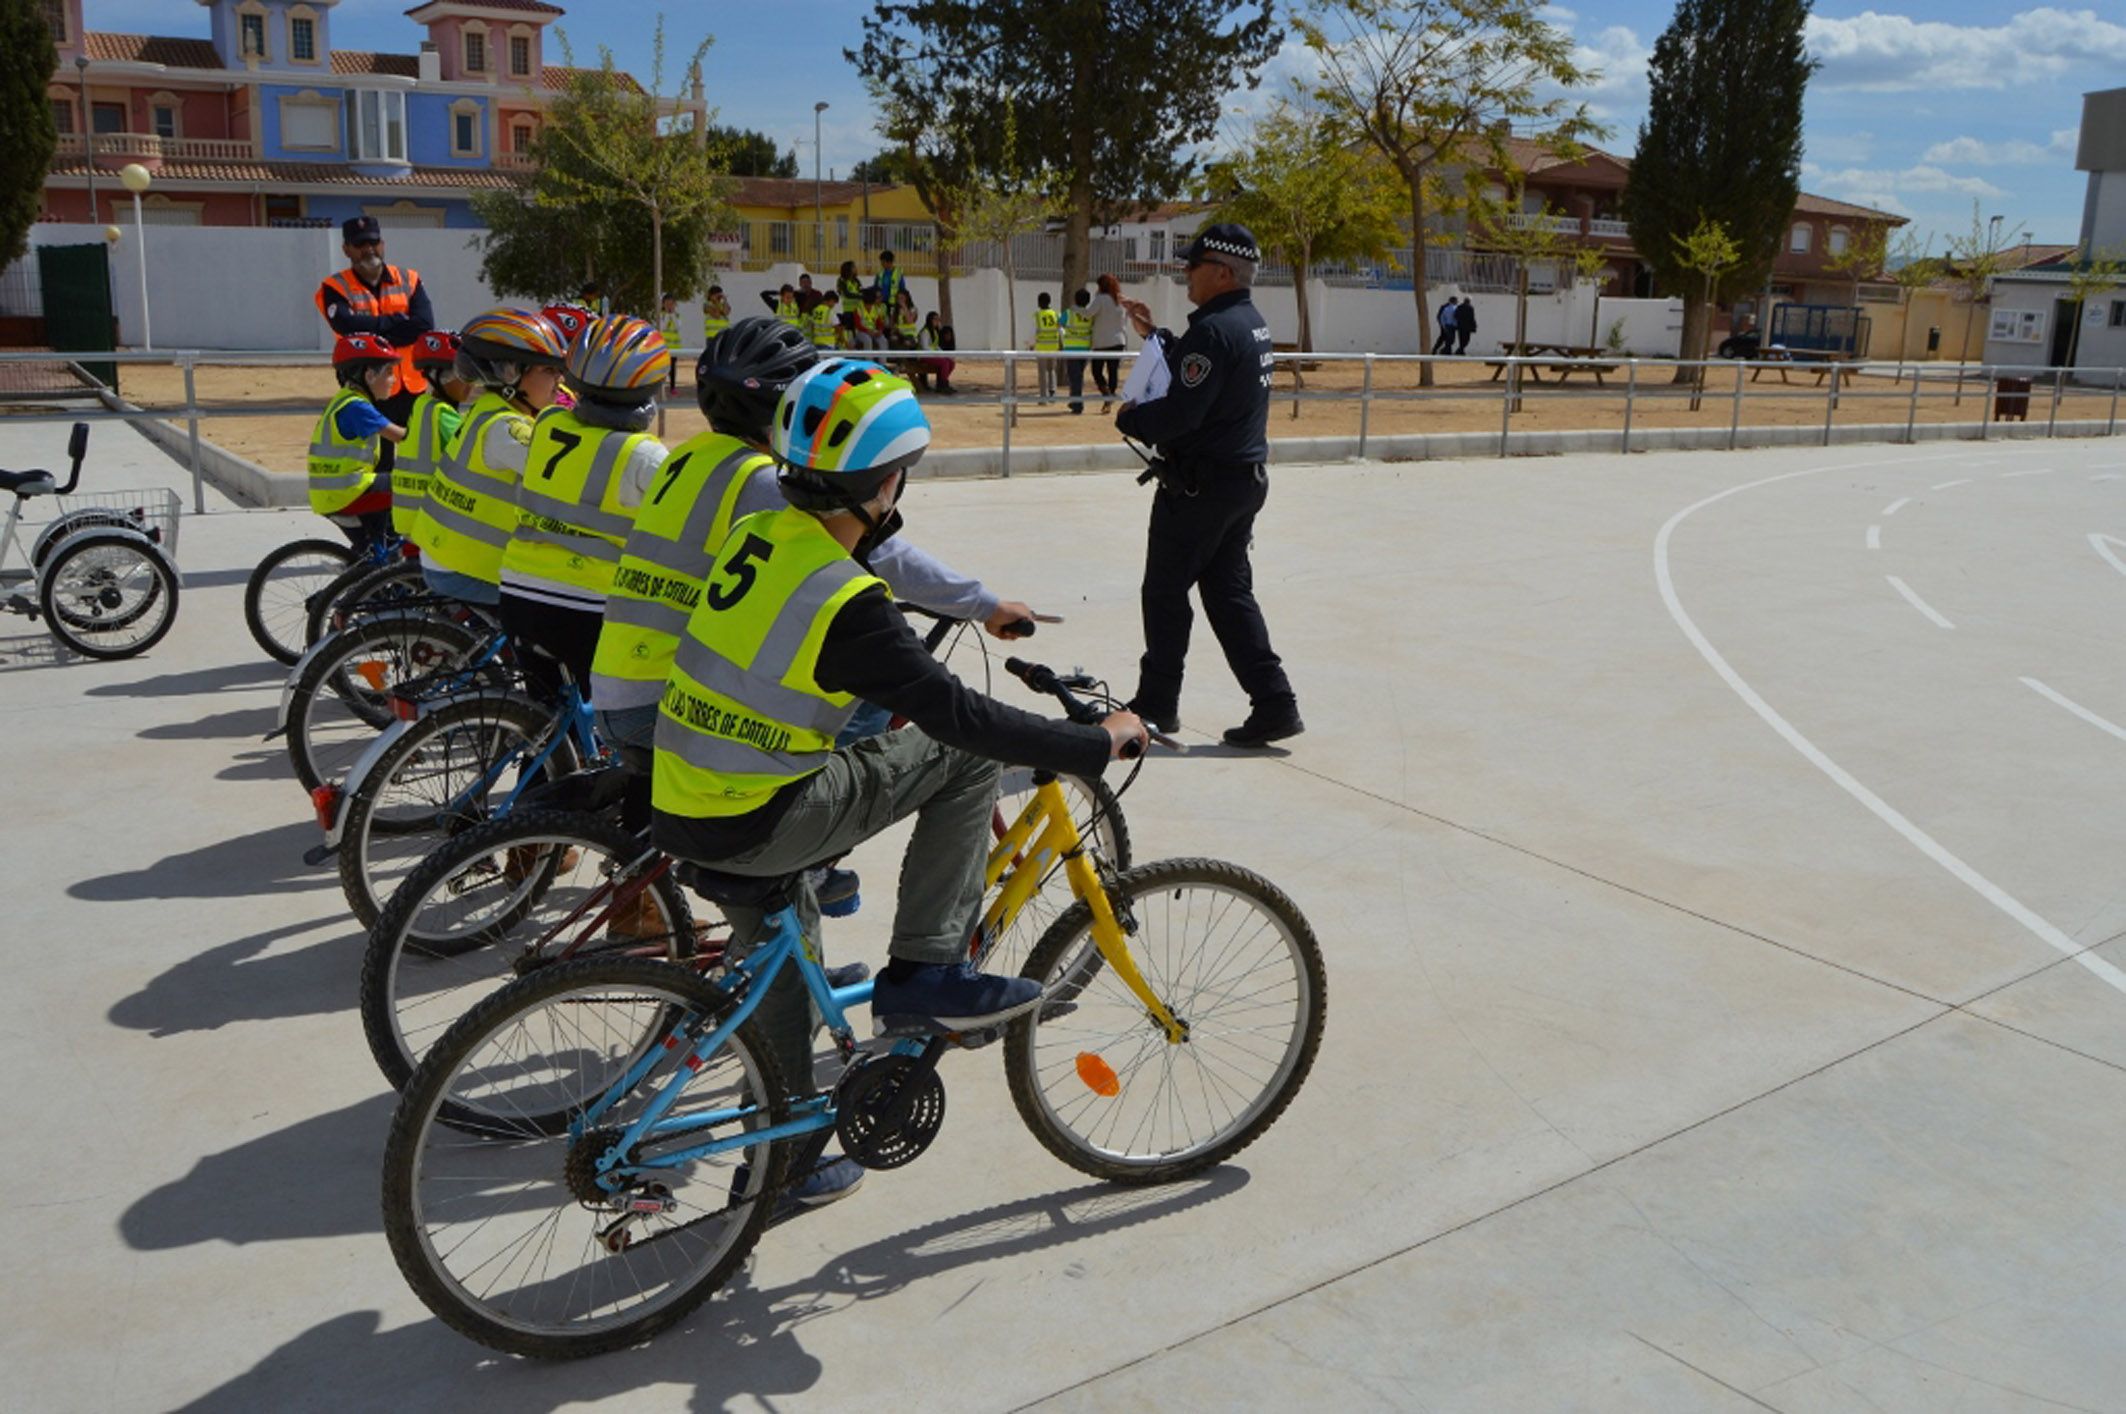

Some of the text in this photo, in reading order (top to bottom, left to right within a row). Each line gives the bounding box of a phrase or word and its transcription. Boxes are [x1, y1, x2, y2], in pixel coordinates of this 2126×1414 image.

[1042, 315, 1055, 327] 13
[542, 427, 581, 480] 7
[652, 452, 693, 505] 1
[707, 532, 774, 611] 5
[720, 712, 739, 736] DE
[737, 717, 791, 751] COTILLAS
